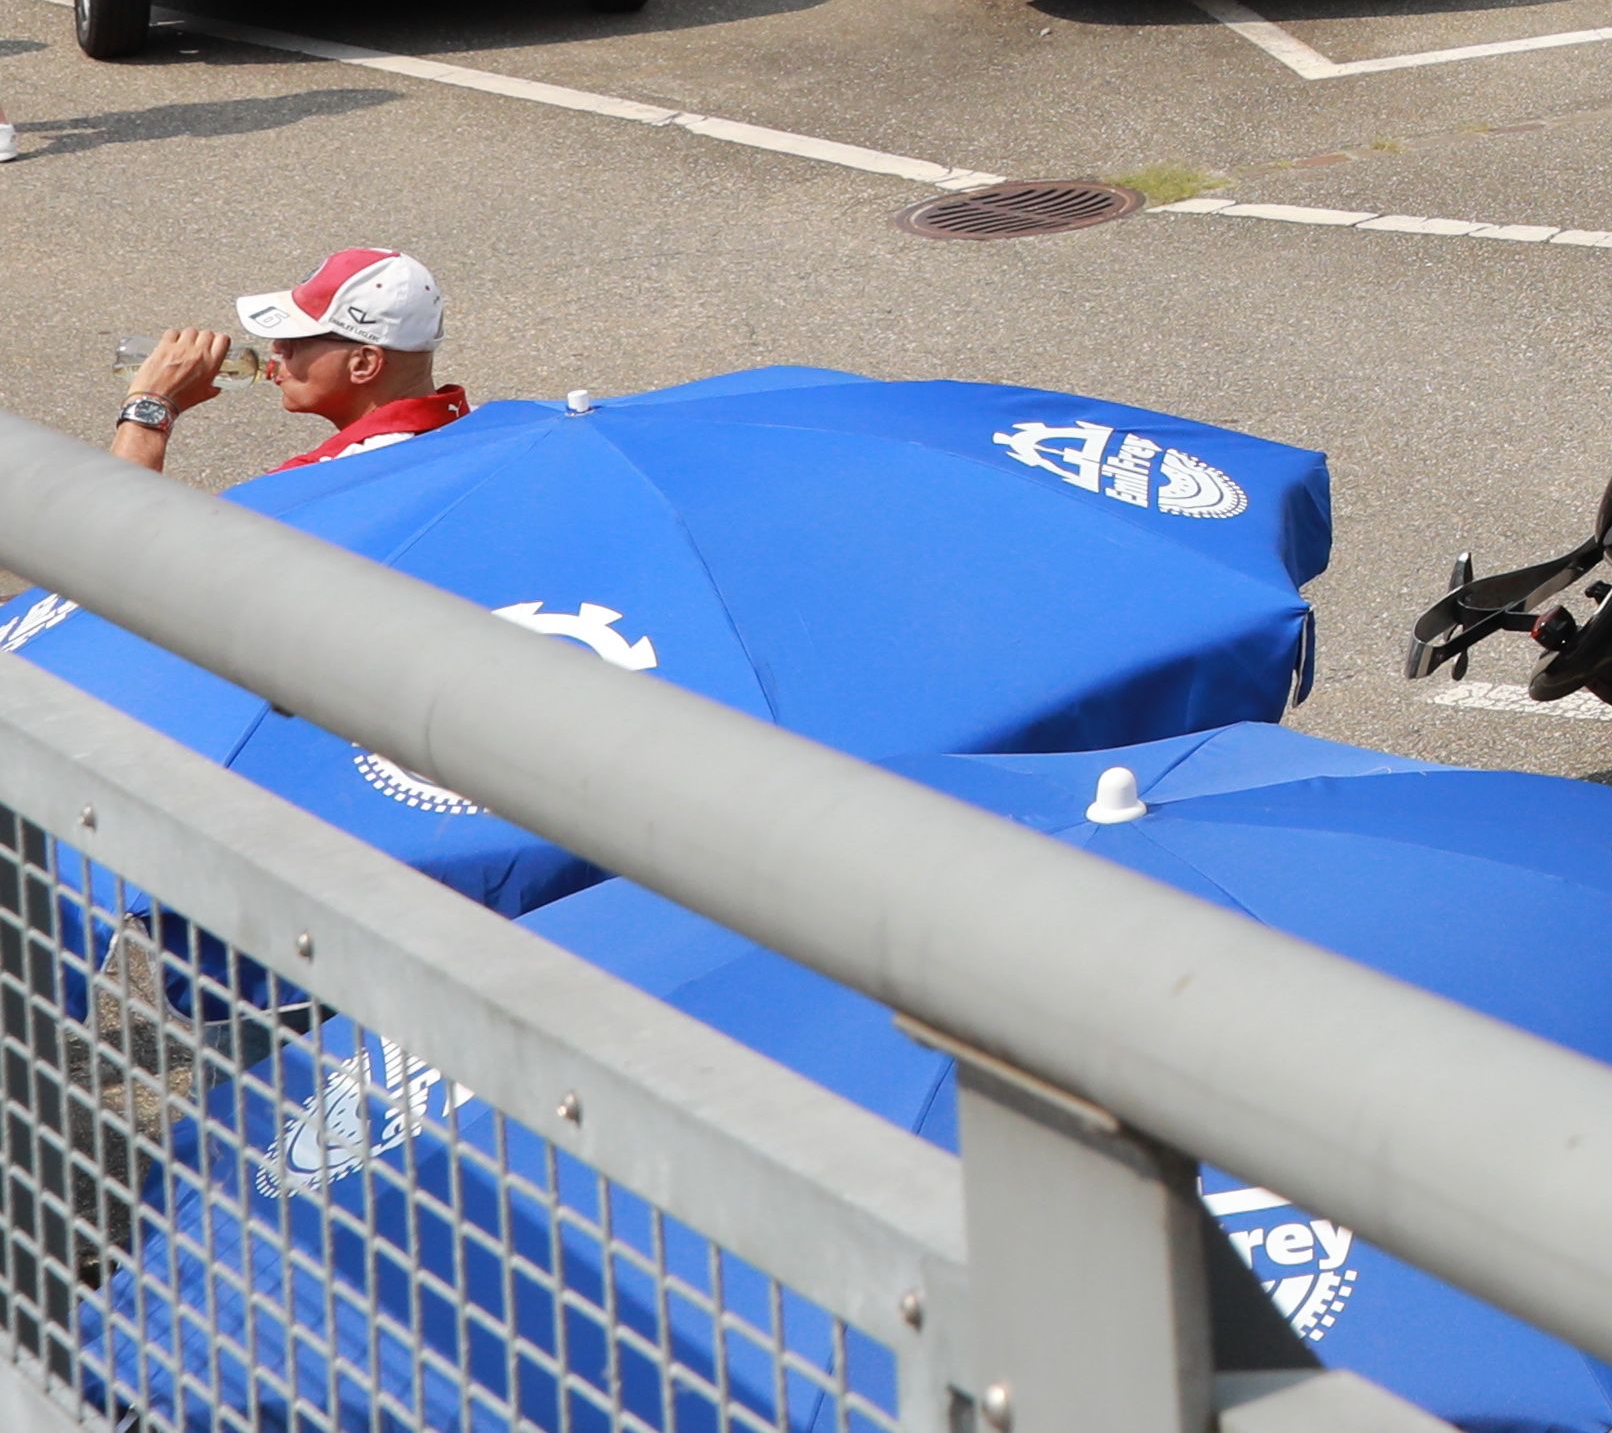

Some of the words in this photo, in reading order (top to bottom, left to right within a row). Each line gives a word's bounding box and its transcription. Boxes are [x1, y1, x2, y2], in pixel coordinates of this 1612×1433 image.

[355, 328, 381, 343] LECLERC
[1119, 433, 1163, 468] Frey
[1103, 466, 1150, 509] Emil
[1226, 1219, 1354, 1270] rey
